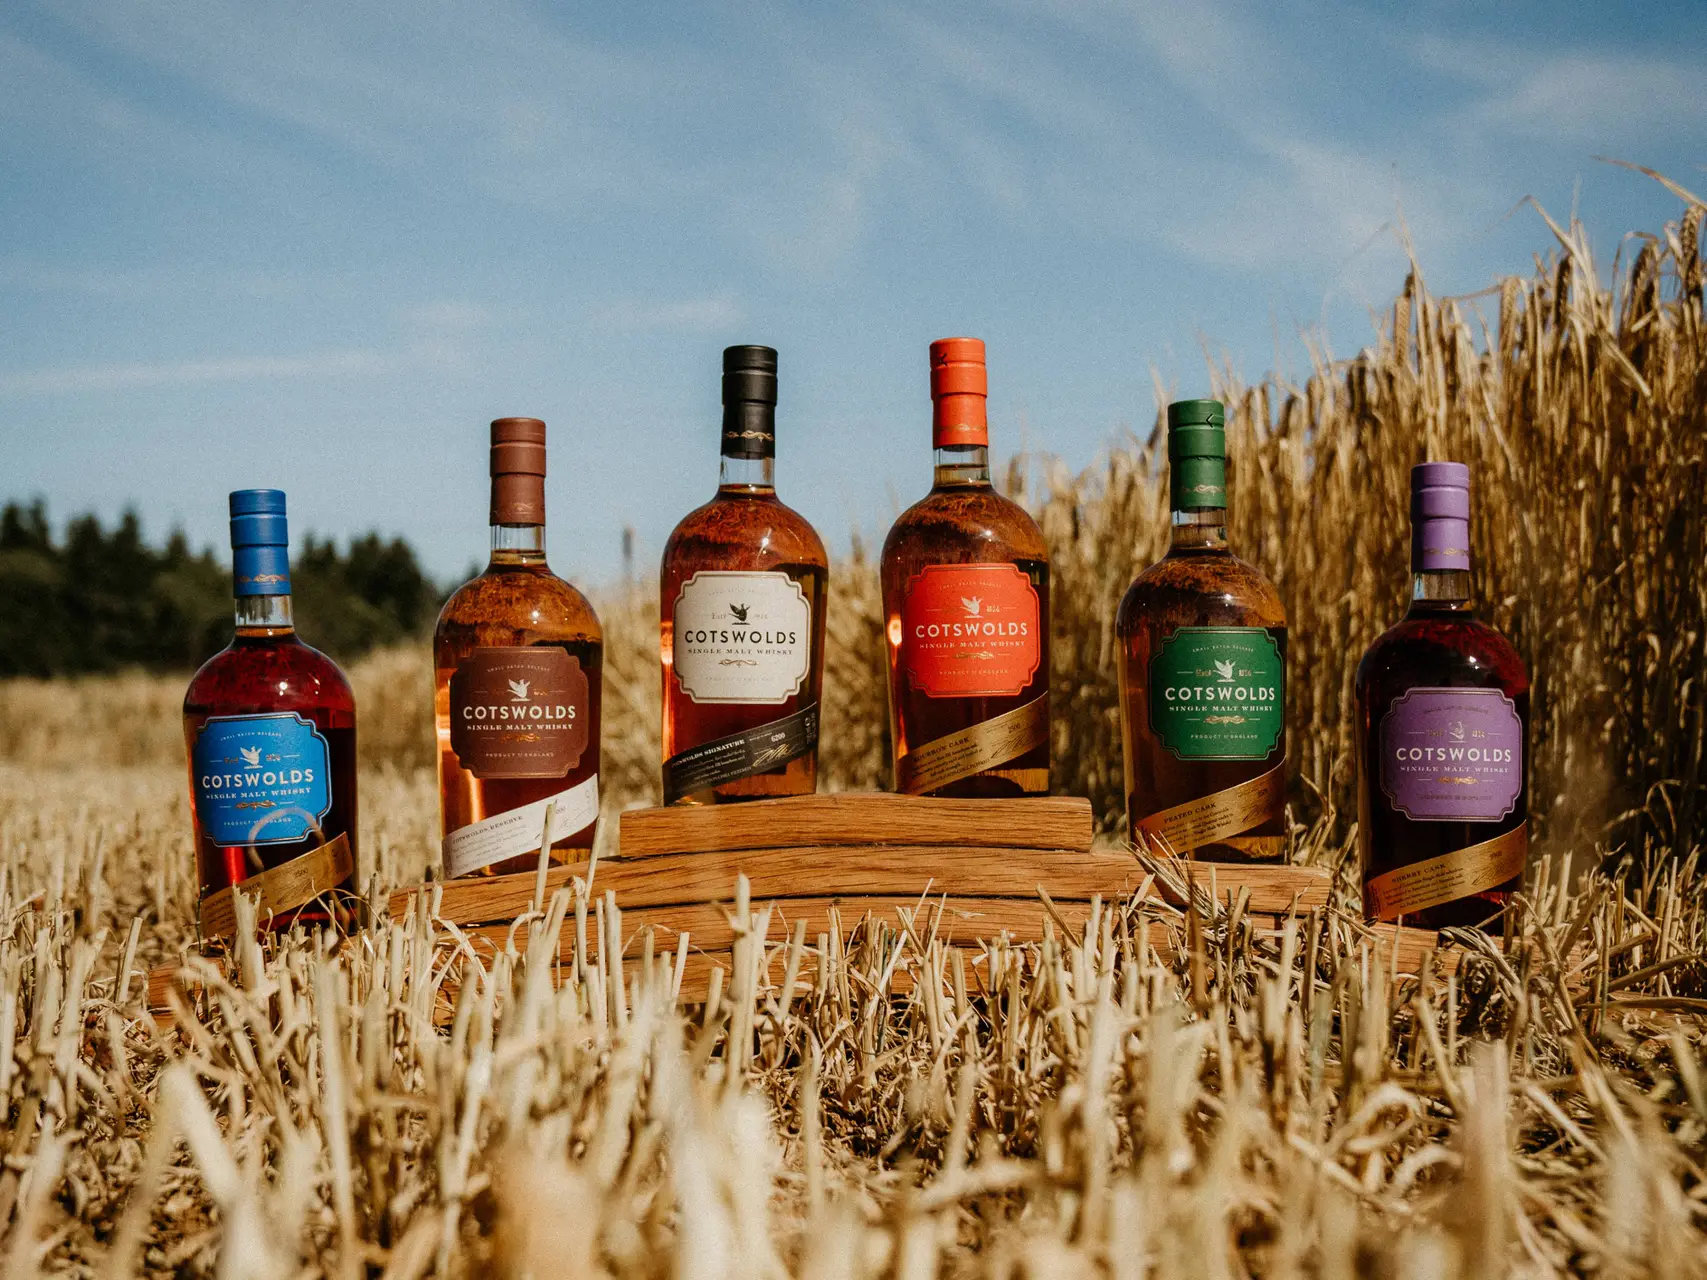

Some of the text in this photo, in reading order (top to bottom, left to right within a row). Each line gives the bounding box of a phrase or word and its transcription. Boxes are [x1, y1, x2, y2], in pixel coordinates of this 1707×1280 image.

[685, 630, 796, 644] COTSWOLDS
[915, 622, 1028, 638] COTSWOLDS
[1165, 687, 1275, 701] COTSWOLDS
[463, 705, 576, 720] COTSWOLDS
[703, 739, 746, 756] SIGNATURE
[948, 736, 970, 748] CASK
[1396, 748, 1512, 763] COTSWOLDS
[202, 768, 315, 789] COTSWOLDS
[206, 787, 312, 800] SINGLE MALT WHISKY
[1163, 801, 1217, 824] PEATED CASK
[490, 815, 524, 830] RESERVE
[1392, 863, 1446, 883] SHERRY CASK
